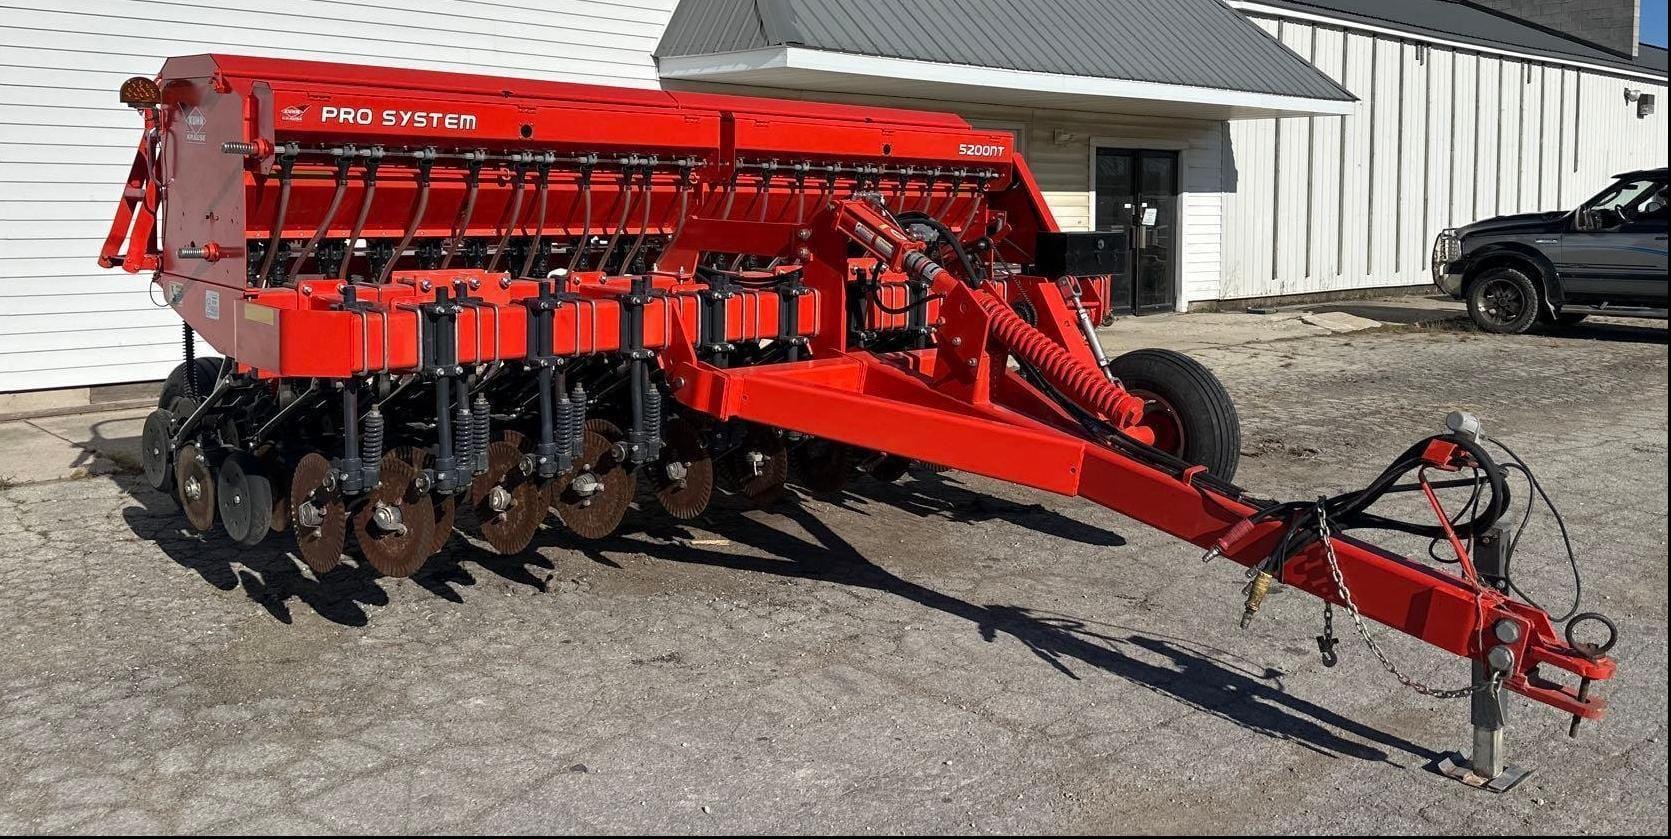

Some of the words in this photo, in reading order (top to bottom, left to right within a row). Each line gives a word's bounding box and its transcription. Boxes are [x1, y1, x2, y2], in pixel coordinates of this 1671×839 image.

[321, 106, 373, 125] PRO
[382, 109, 477, 130] SYSTEM
[959, 143, 1005, 157] 5200NT
